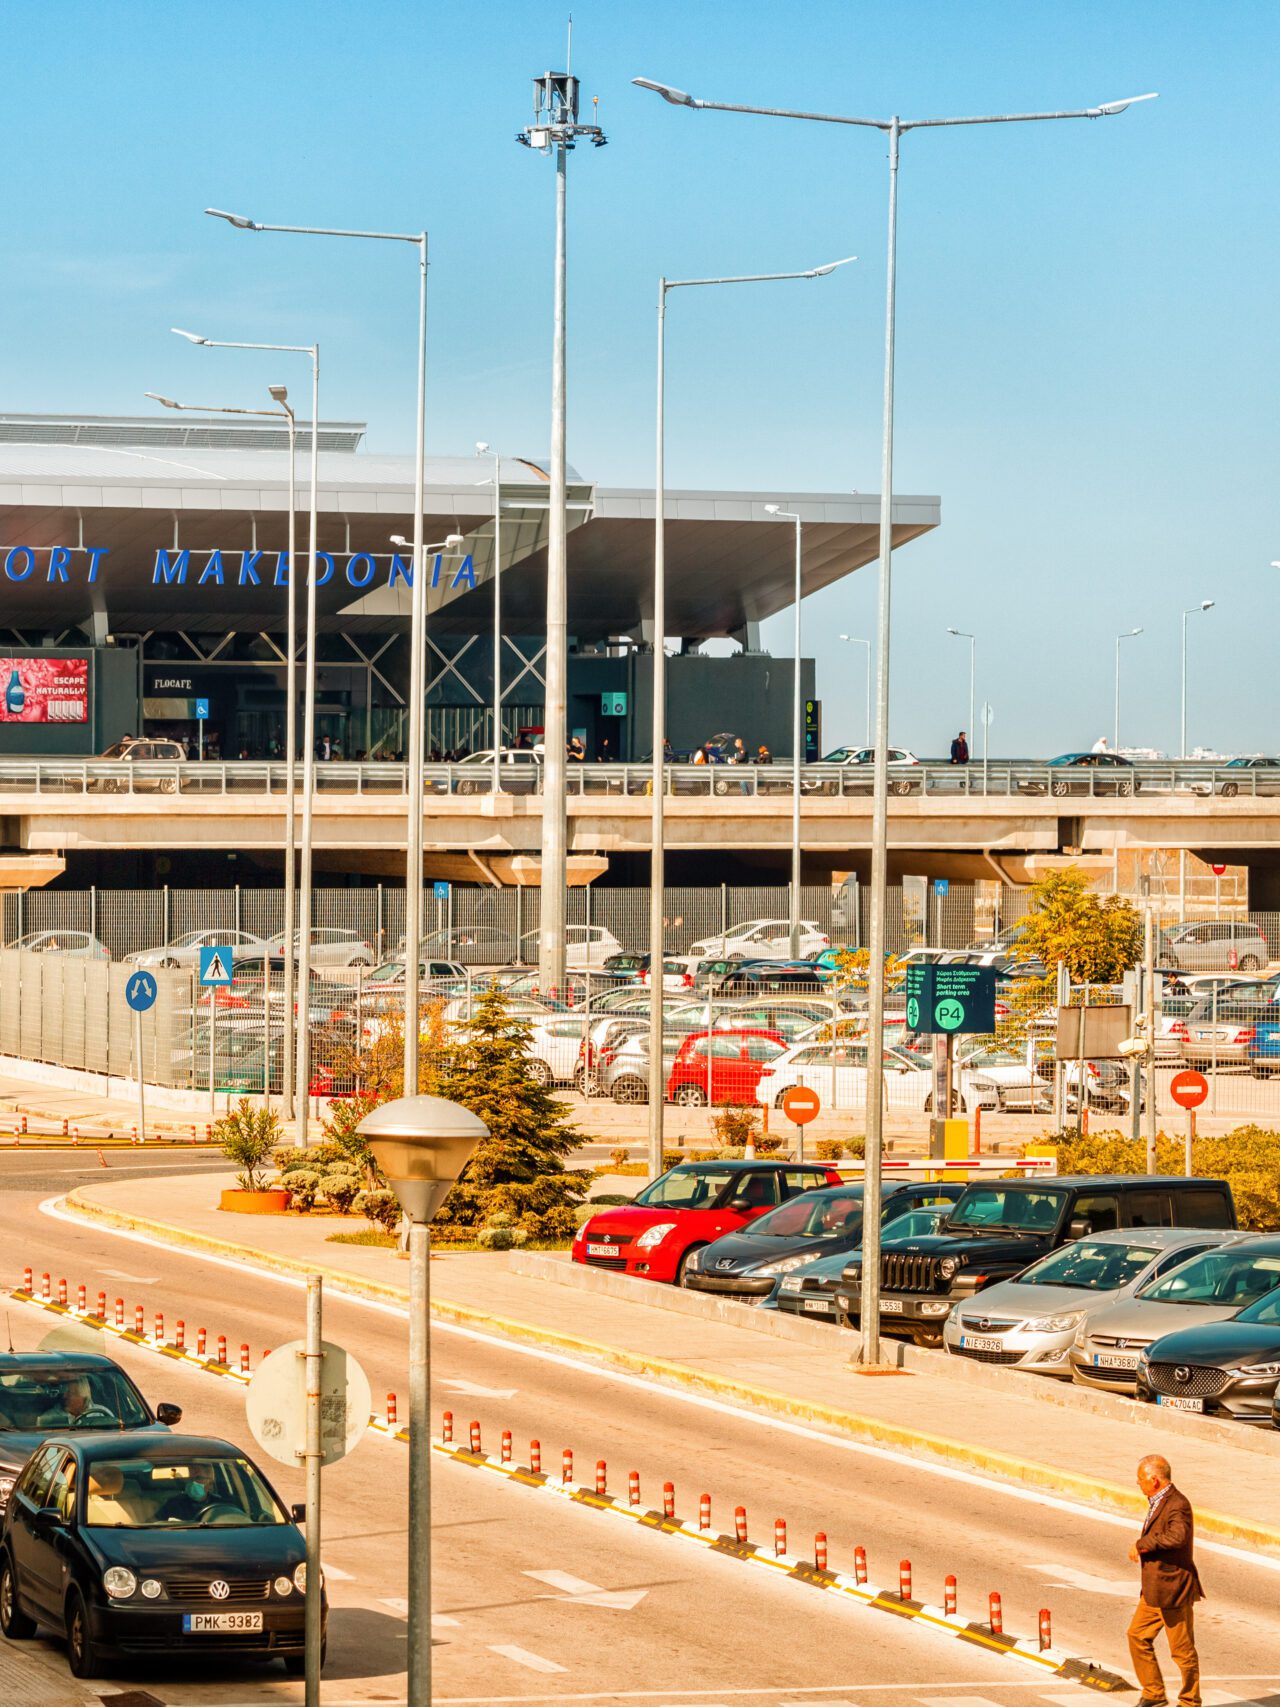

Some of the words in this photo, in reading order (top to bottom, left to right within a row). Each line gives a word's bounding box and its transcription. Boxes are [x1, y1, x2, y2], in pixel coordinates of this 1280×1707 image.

[152, 549, 476, 588] MAKEDONIA
[154, 679, 192, 689] FLOCAFE
[909, 1006, 918, 1018] P4
[939, 1007, 961, 1021] P4
[195, 1615, 261, 1629] PMK-9382
